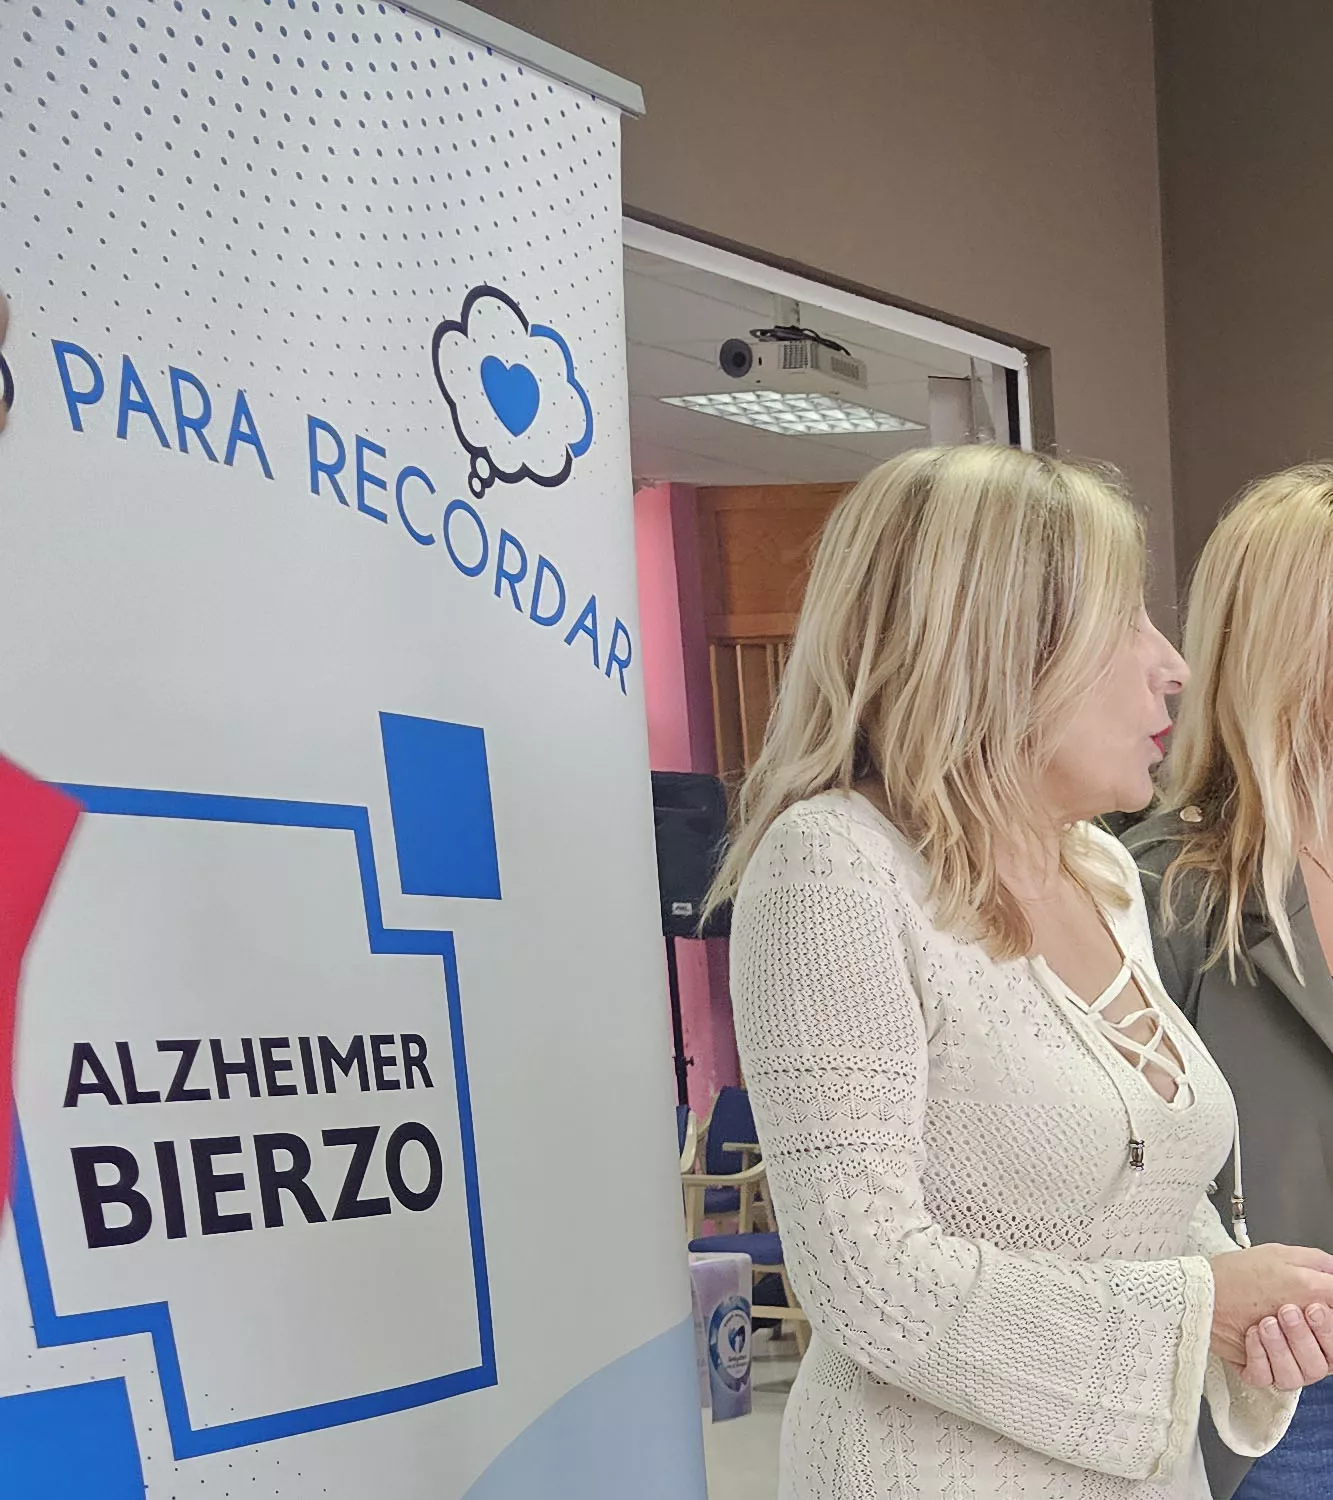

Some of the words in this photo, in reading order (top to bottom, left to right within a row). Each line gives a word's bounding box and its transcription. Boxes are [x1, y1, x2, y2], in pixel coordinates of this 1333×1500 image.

[51, 339, 274, 480] PARA
[307, 414, 632, 695] RECORDAR
[63, 1033, 435, 1108] ALZHEIMER
[70, 1121, 443, 1249] BIERZO
